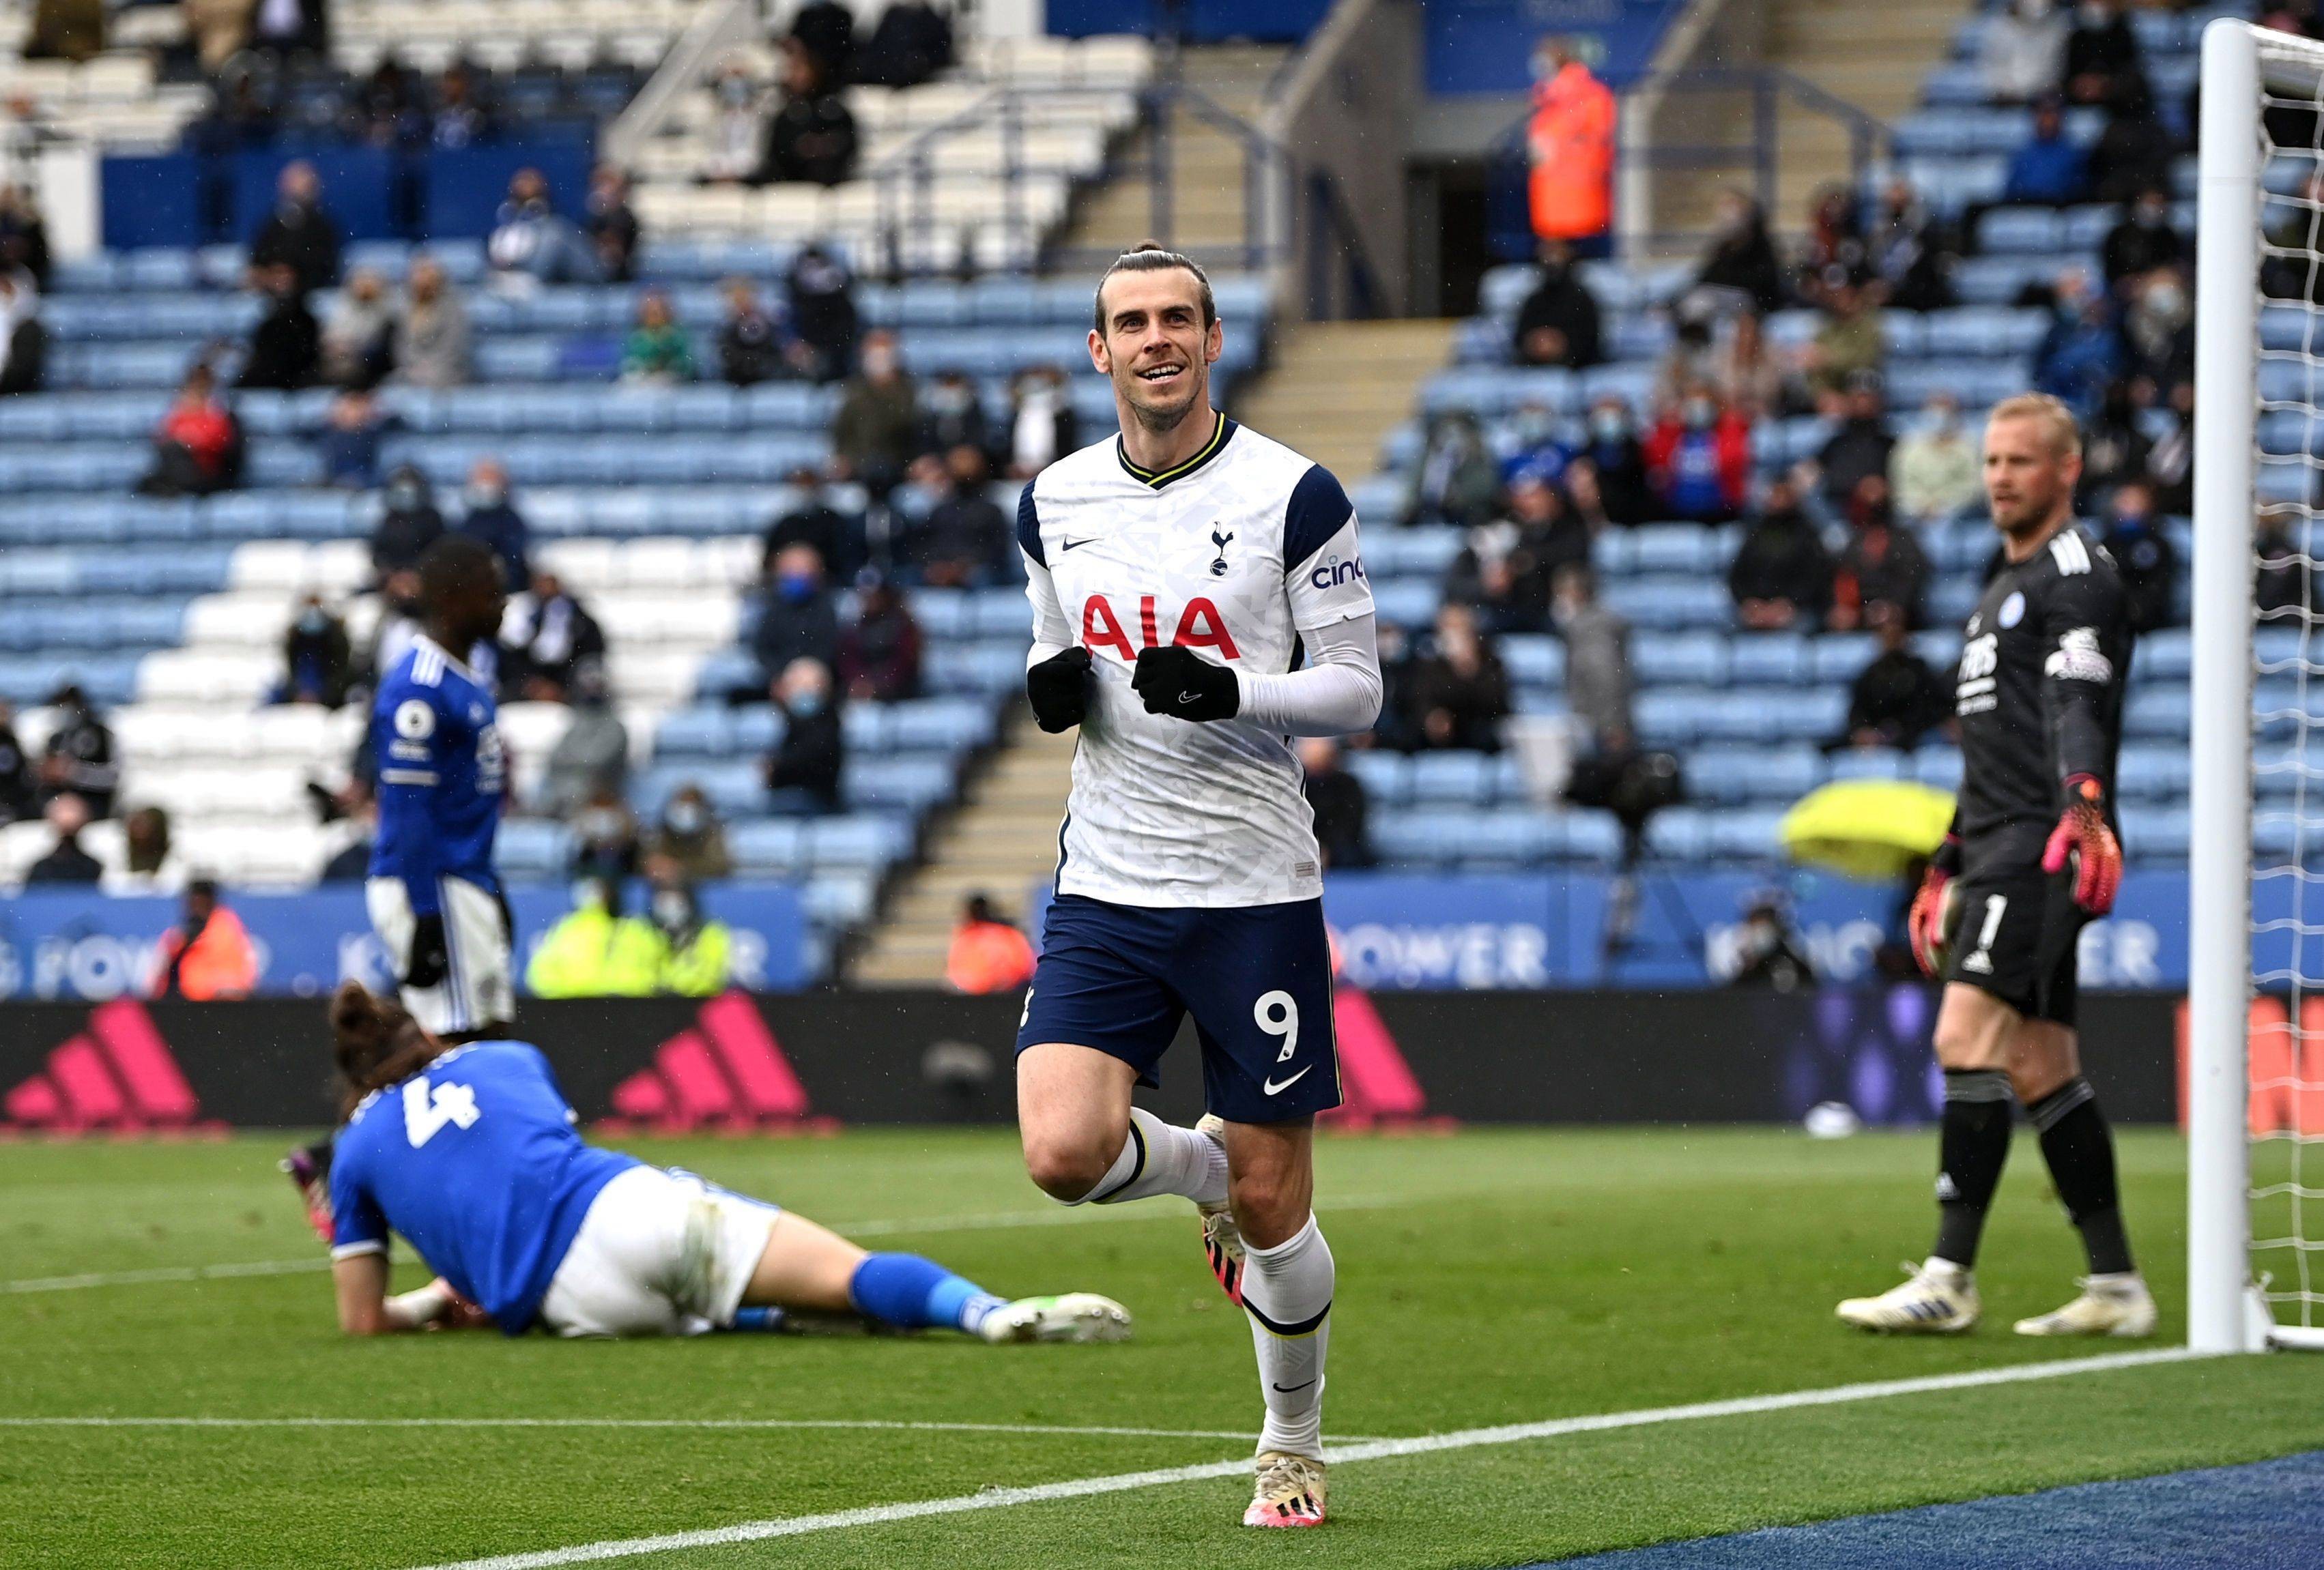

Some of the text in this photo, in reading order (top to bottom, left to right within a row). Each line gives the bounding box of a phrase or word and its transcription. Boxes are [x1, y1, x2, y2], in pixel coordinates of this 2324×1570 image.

[1082, 595, 1241, 660] AIA
[1977, 893, 2008, 950] 1
[1333, 922, 1549, 989] OWER
[1254, 989, 1299, 1063] 9
[402, 1075, 482, 1150] 4
